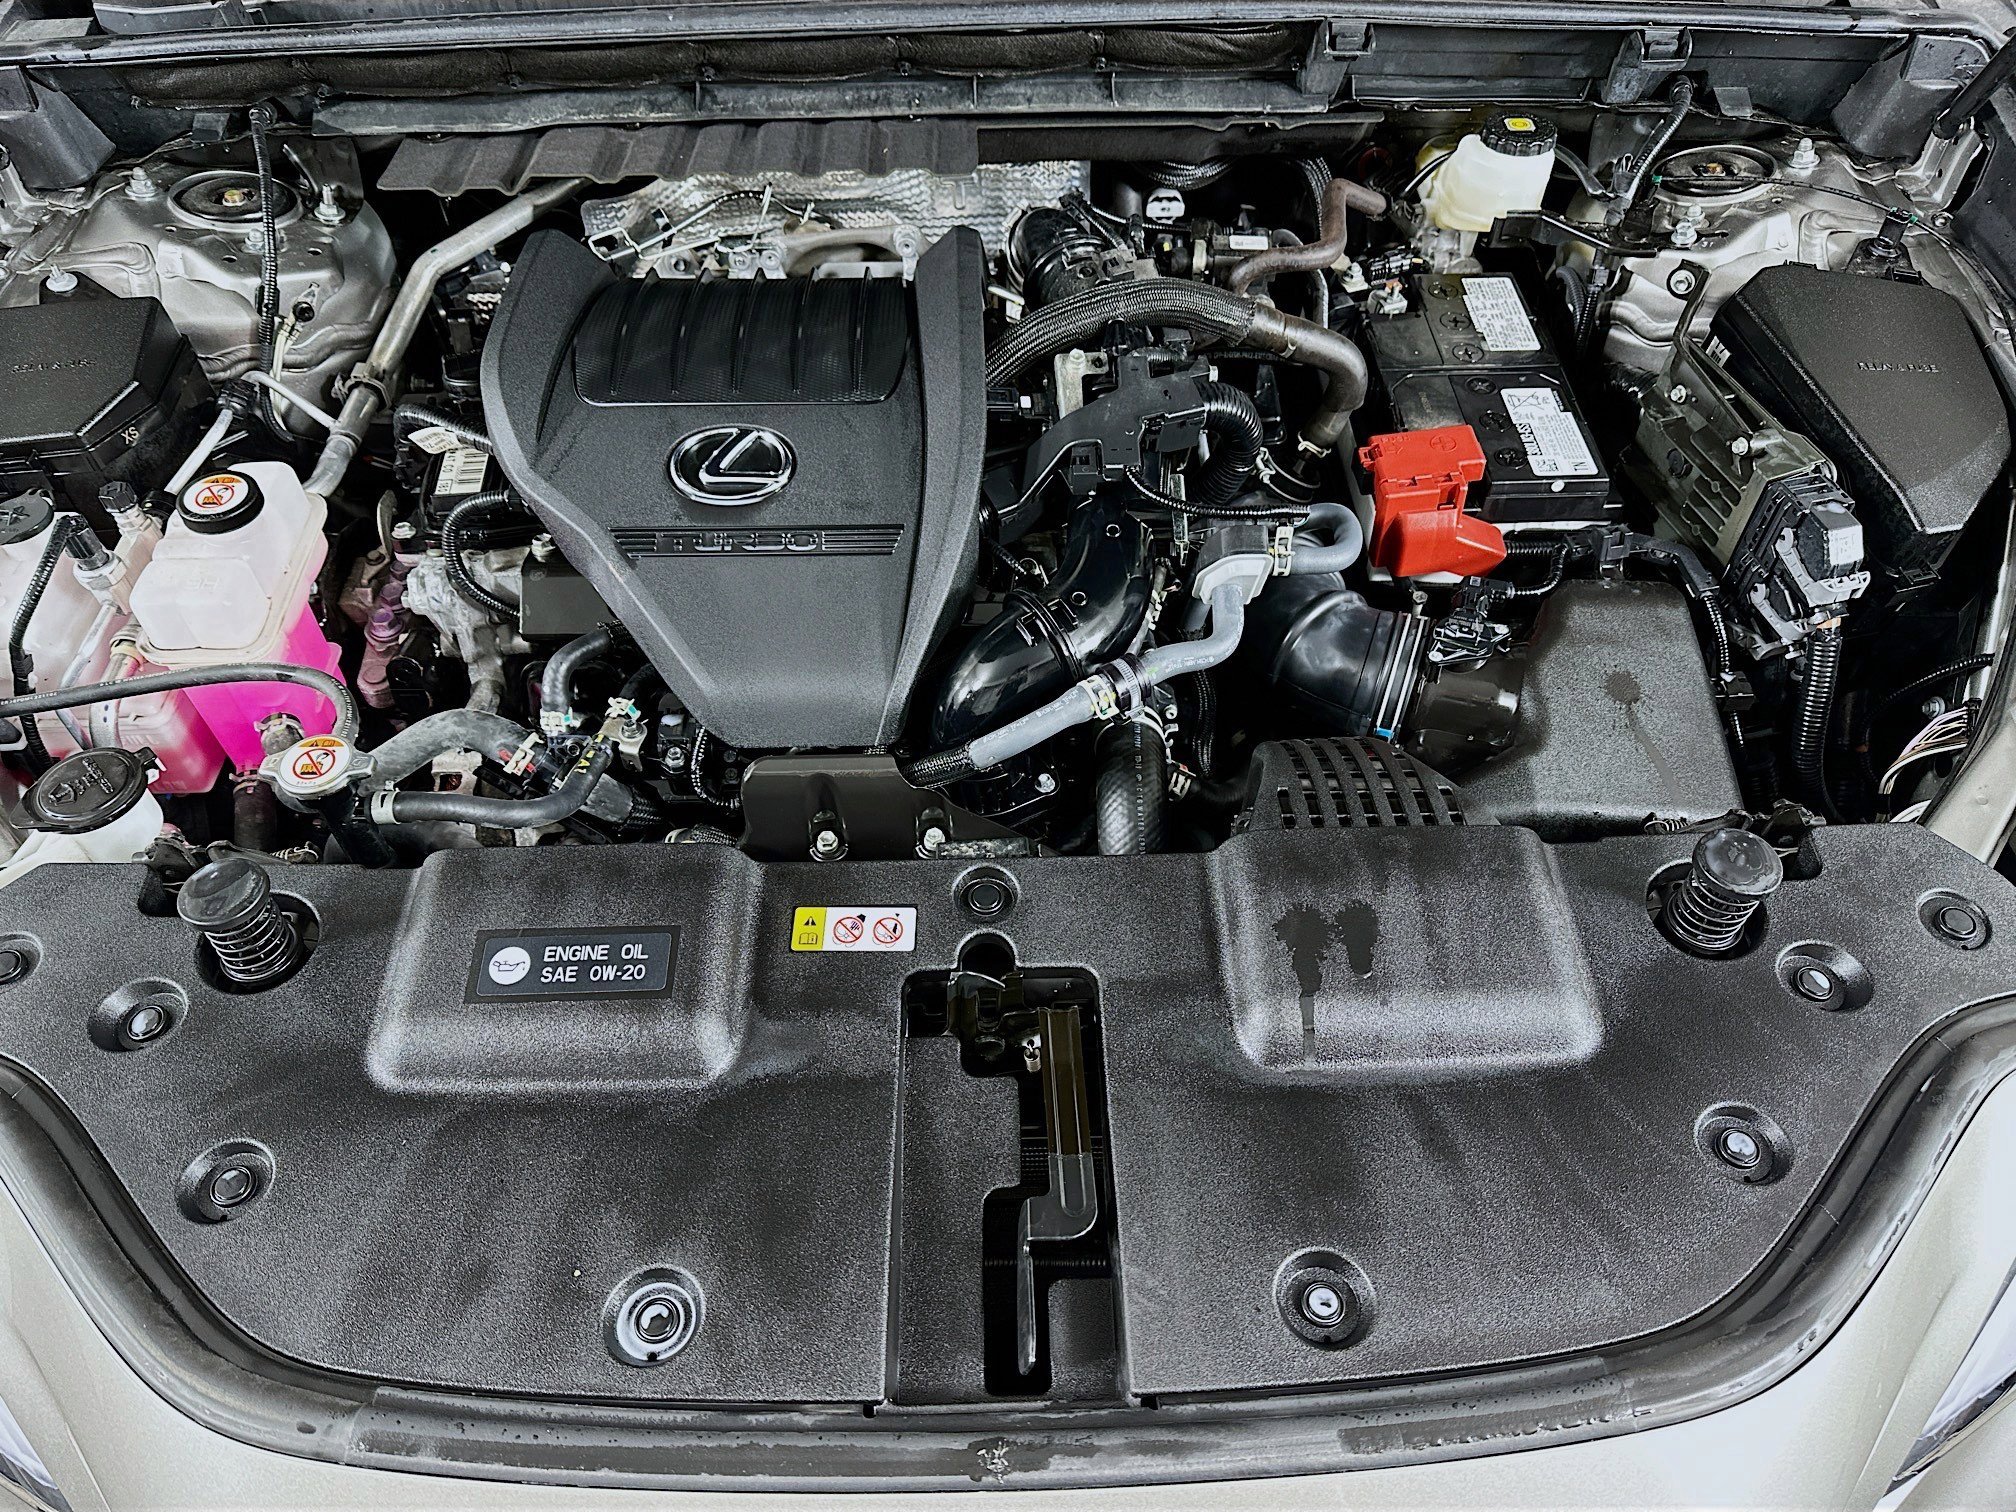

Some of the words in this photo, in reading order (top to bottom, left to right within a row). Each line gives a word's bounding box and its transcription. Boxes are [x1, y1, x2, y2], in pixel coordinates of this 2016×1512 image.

[543, 944, 610, 962] ENGINE
[621, 943, 649, 960] OIL
[540, 966, 579, 983] SAE
[589, 964, 646, 982] 0W-20
